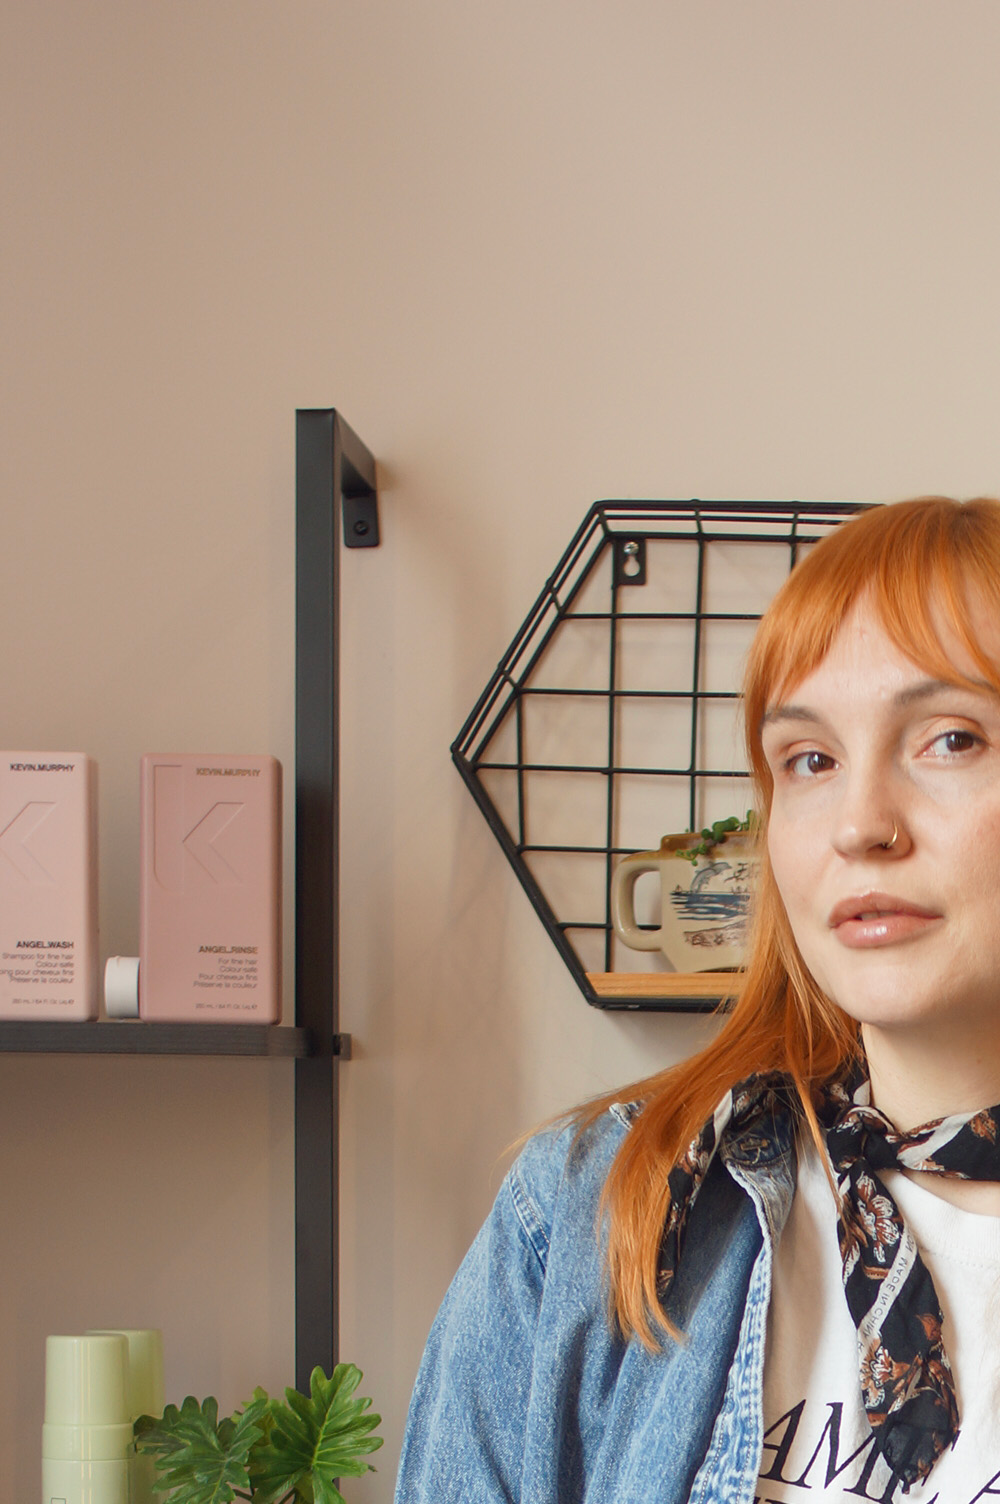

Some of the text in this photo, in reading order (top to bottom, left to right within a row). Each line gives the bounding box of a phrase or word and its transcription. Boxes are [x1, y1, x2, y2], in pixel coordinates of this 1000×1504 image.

[9, 763, 75, 773] KEVIN.MURPHY
[196, 767, 261, 777] KEVIN.MURPHY
[16, 940, 75, 949] ANGEL.WASH
[198, 945, 259, 954] ANGEL.RINSE
